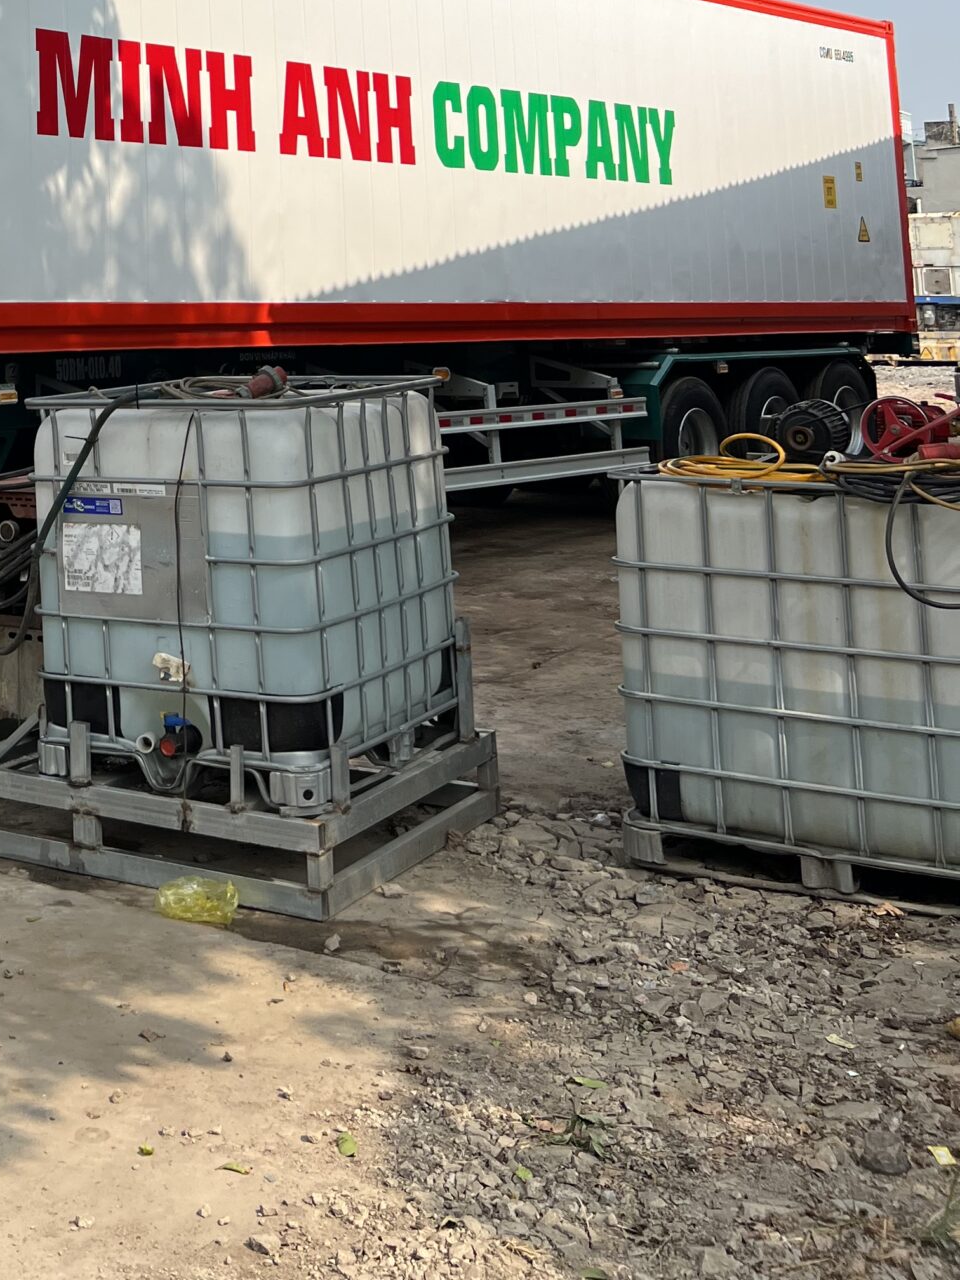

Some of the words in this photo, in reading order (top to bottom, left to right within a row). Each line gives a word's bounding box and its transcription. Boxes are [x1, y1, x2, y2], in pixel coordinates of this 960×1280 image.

[35, 28, 256, 152] MINH
[279, 61, 416, 165] ANH
[432, 81, 675, 185] COMPANY
